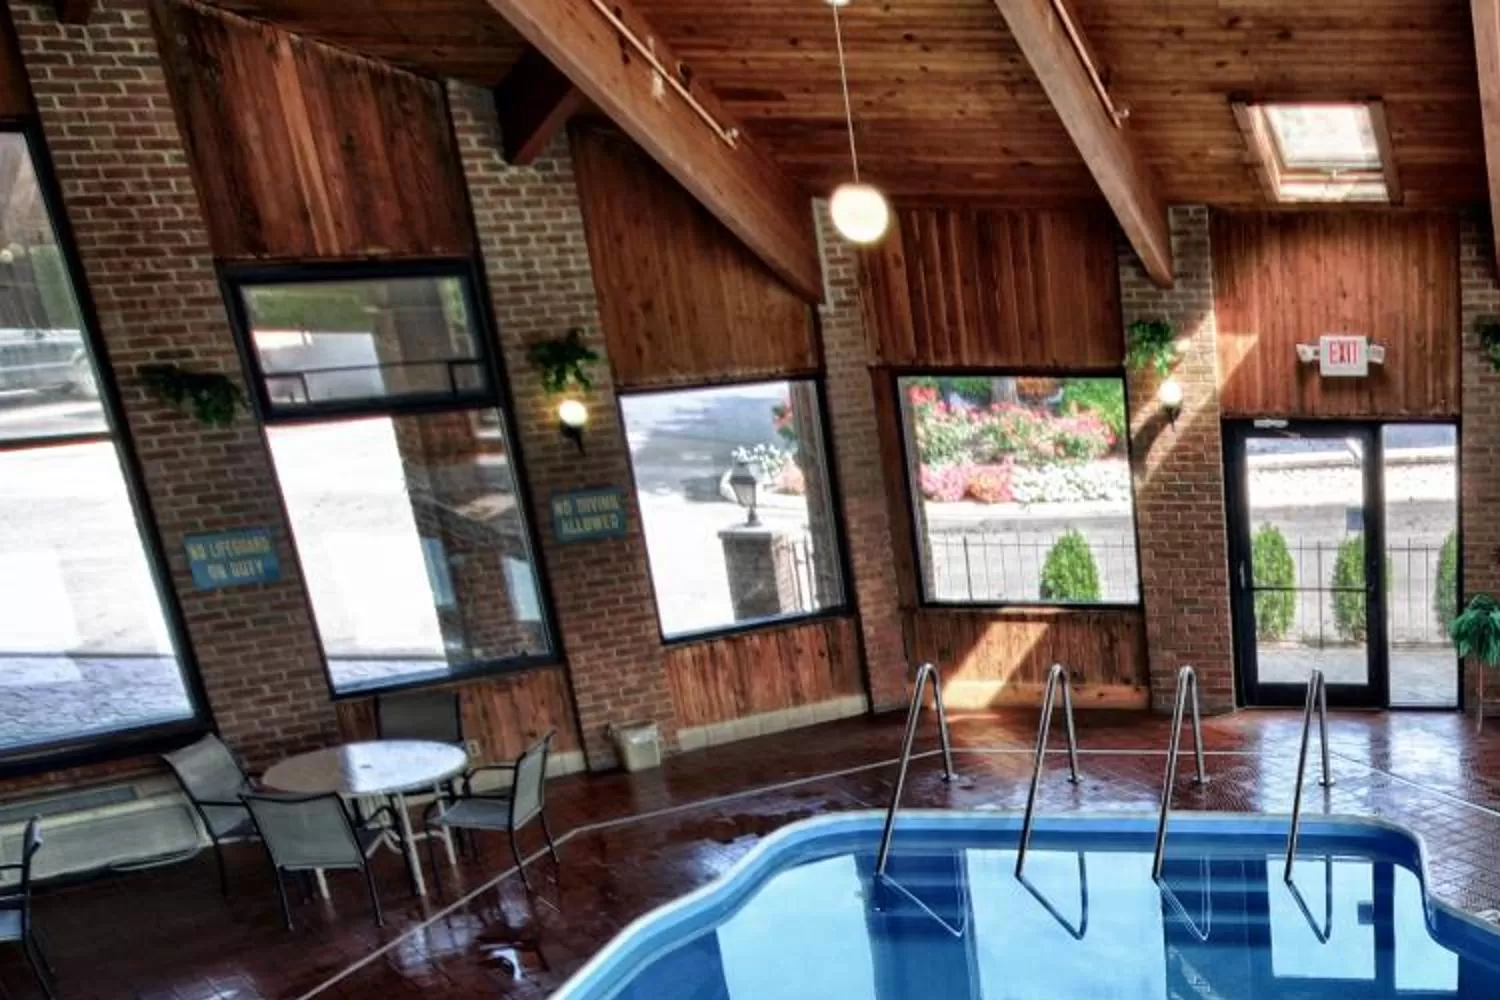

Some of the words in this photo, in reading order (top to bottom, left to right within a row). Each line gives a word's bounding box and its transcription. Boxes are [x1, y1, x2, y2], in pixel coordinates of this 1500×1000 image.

[1328, 340, 1358, 365] EXIT
[552, 499, 572, 517] NO
[561, 512, 619, 535] ALLOWED
[187, 542, 207, 562] NO
[208, 536, 271, 558] LIFEGUARD
[230, 559, 264, 577] DUTY
